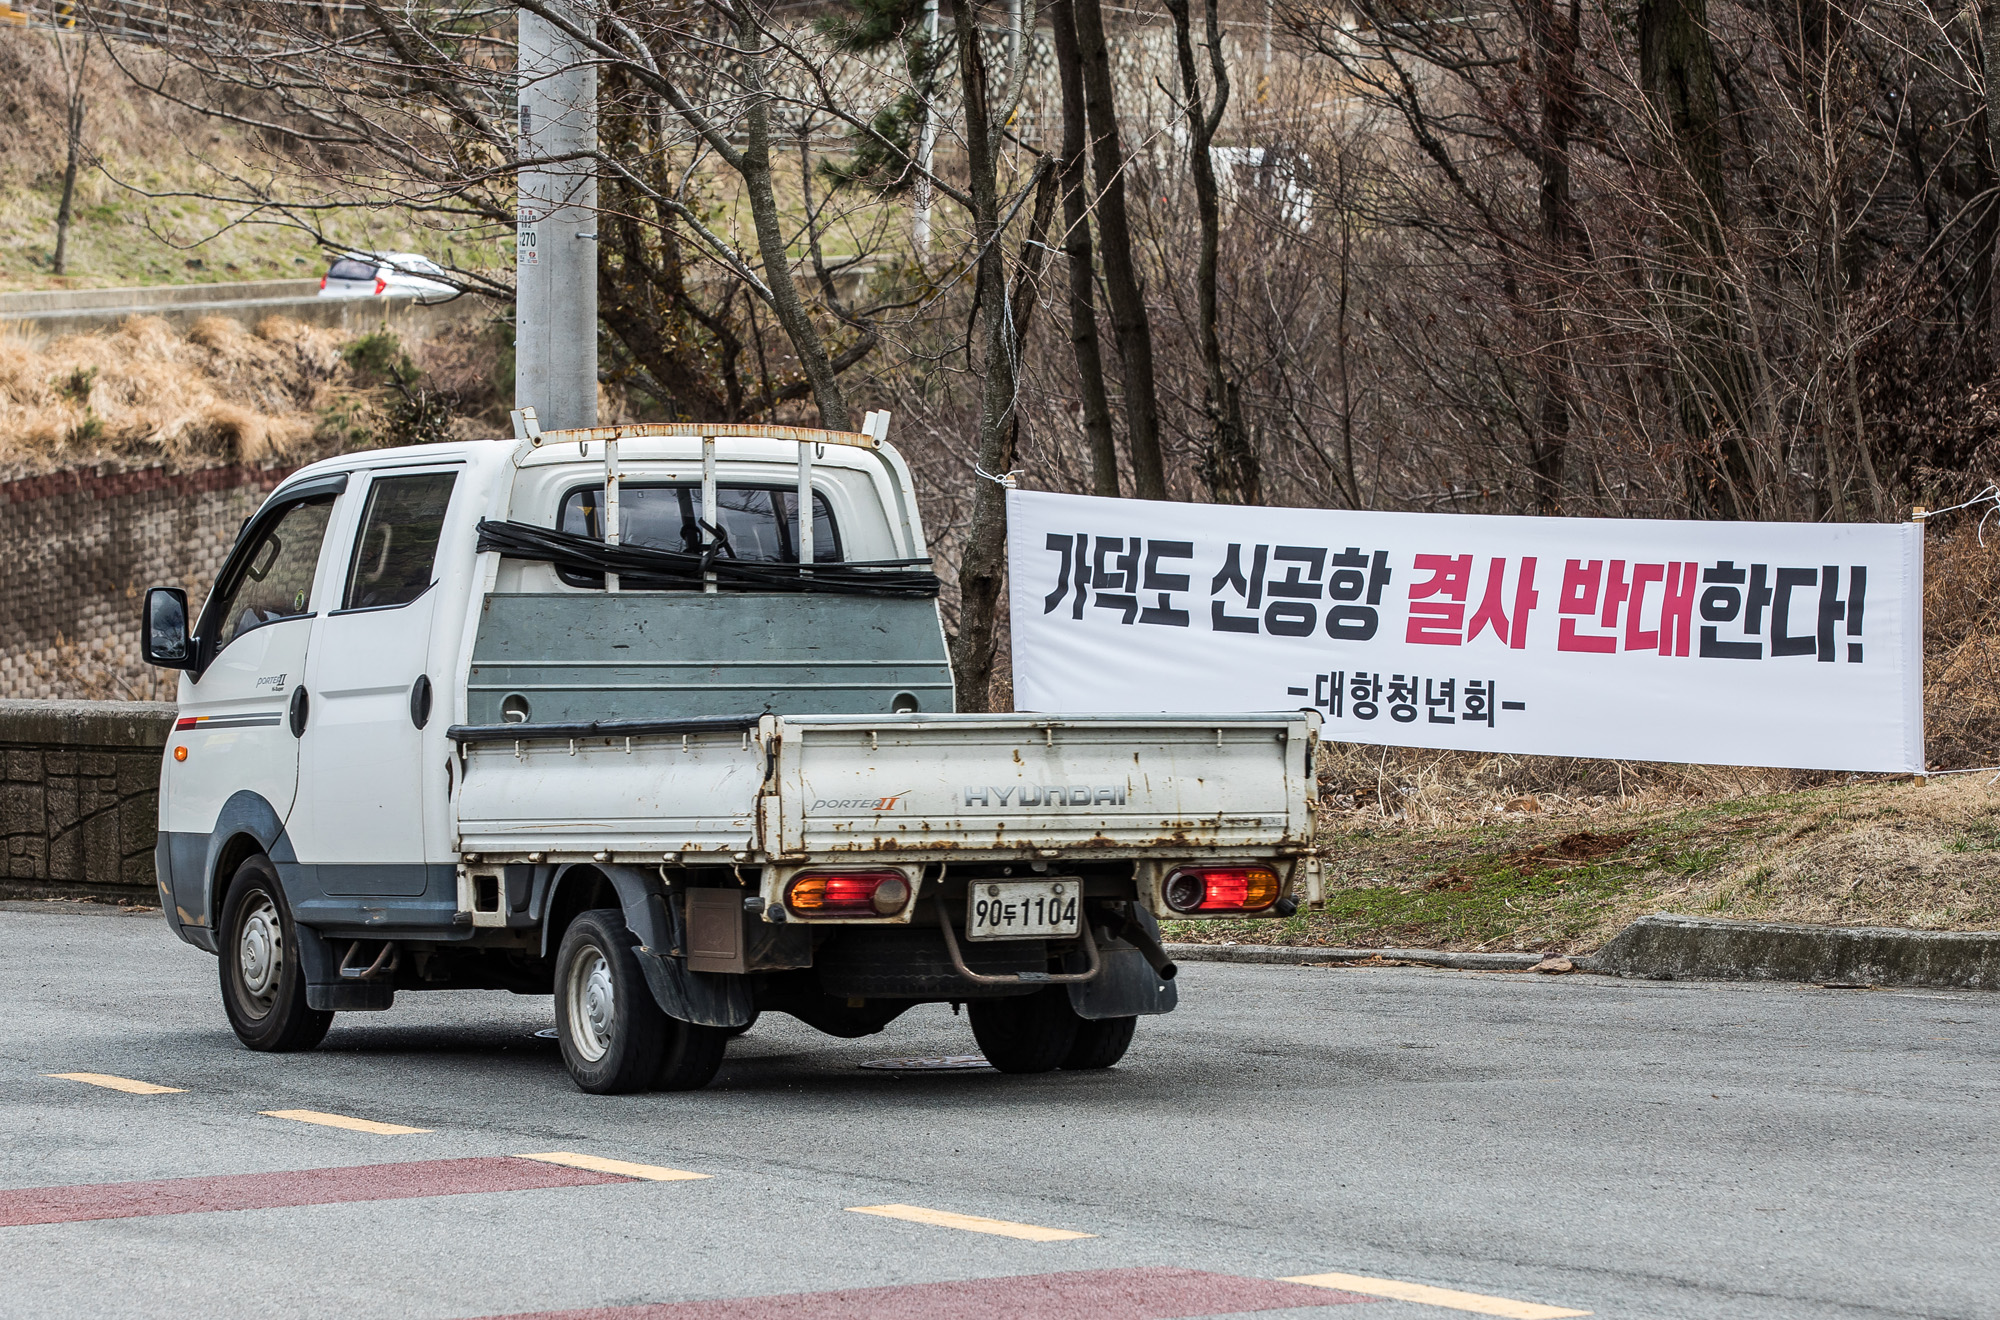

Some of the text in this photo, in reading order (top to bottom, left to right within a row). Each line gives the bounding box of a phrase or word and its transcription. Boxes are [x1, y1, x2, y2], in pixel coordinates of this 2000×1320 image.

[522, 232, 536, 247] 270
[1044, 533, 1867, 663] 가덕도 신공항 결사 반대한다!
[964, 785, 1126, 807] HYUNDAI
[976, 897, 1076, 927] 90두1104
